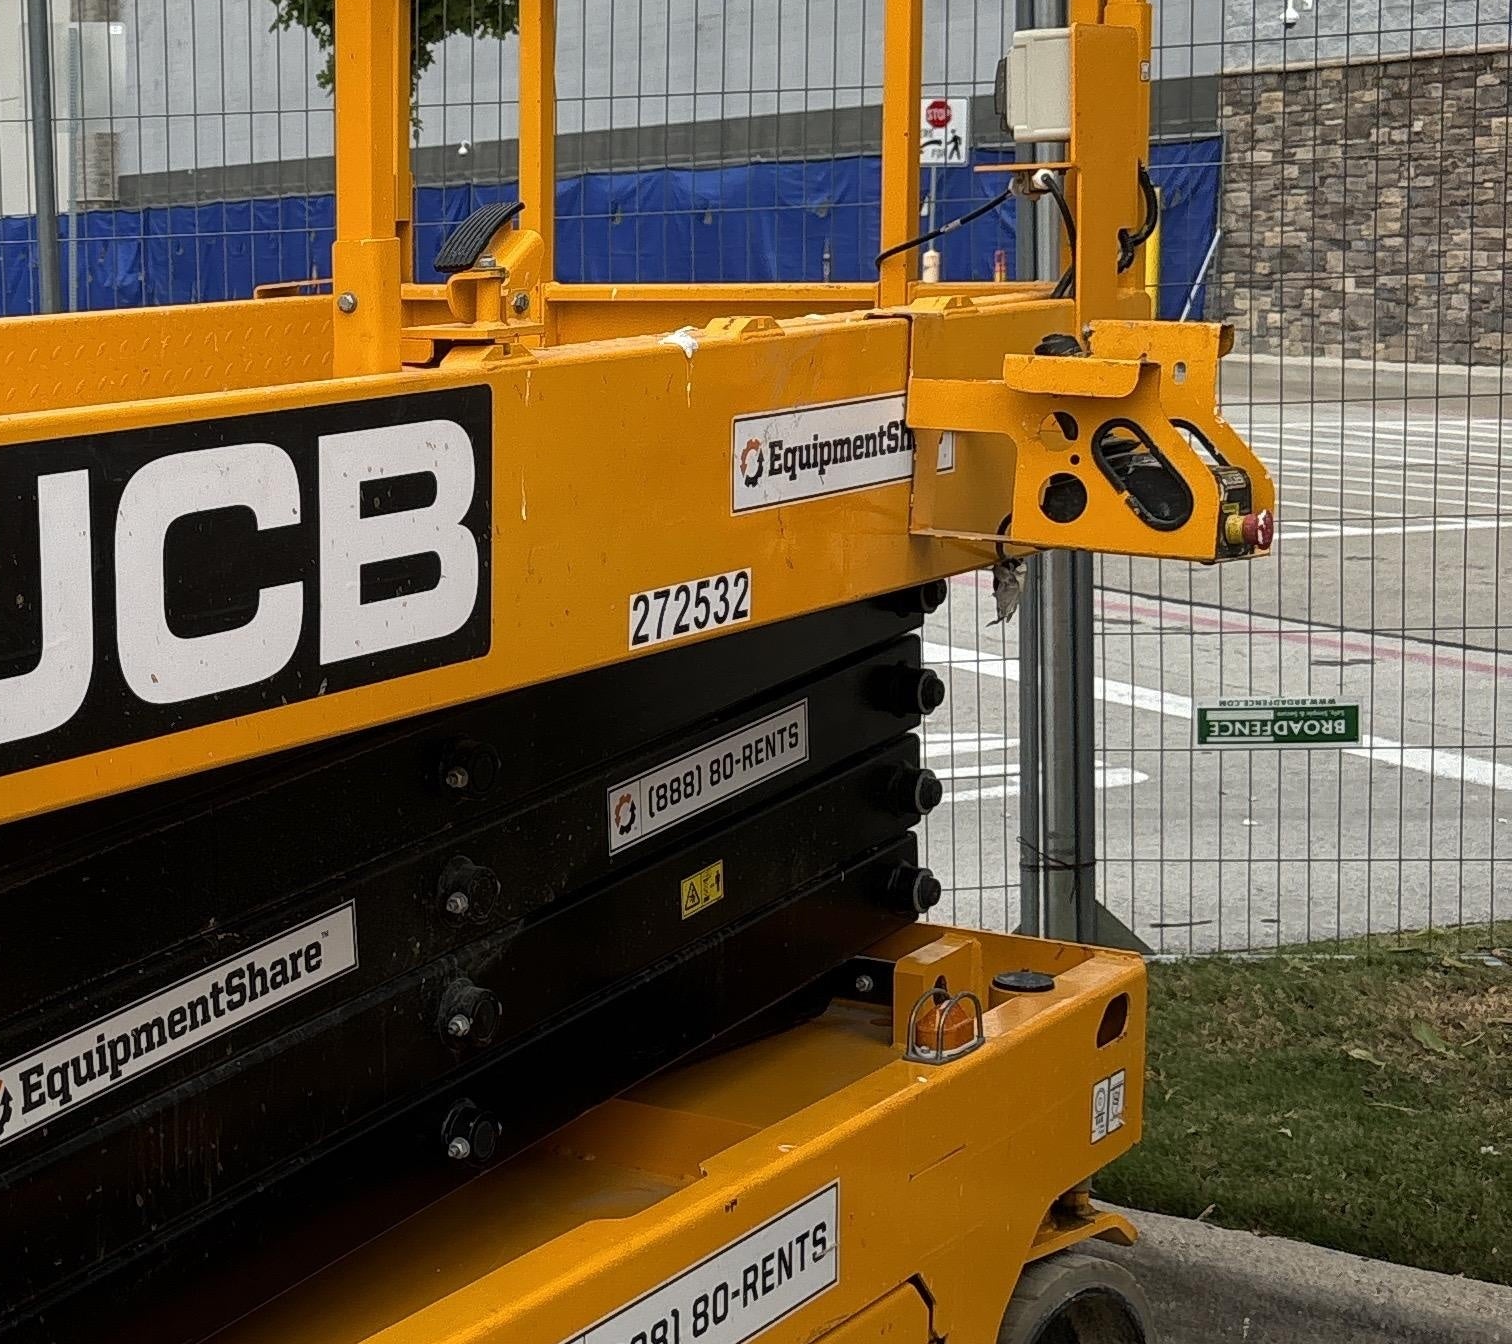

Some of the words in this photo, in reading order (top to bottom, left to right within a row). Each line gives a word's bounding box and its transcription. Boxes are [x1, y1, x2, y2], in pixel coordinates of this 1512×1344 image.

[631, 570, 750, 647] 272532
[648, 764, 703, 819] (888)
[709, 720, 800, 778] 80-RENTS
[1209, 719, 1346, 736] BROADFENCE
[18, 940, 323, 1115] EquipmentShare
[692, 1220, 828, 1338] 80-RENTS
